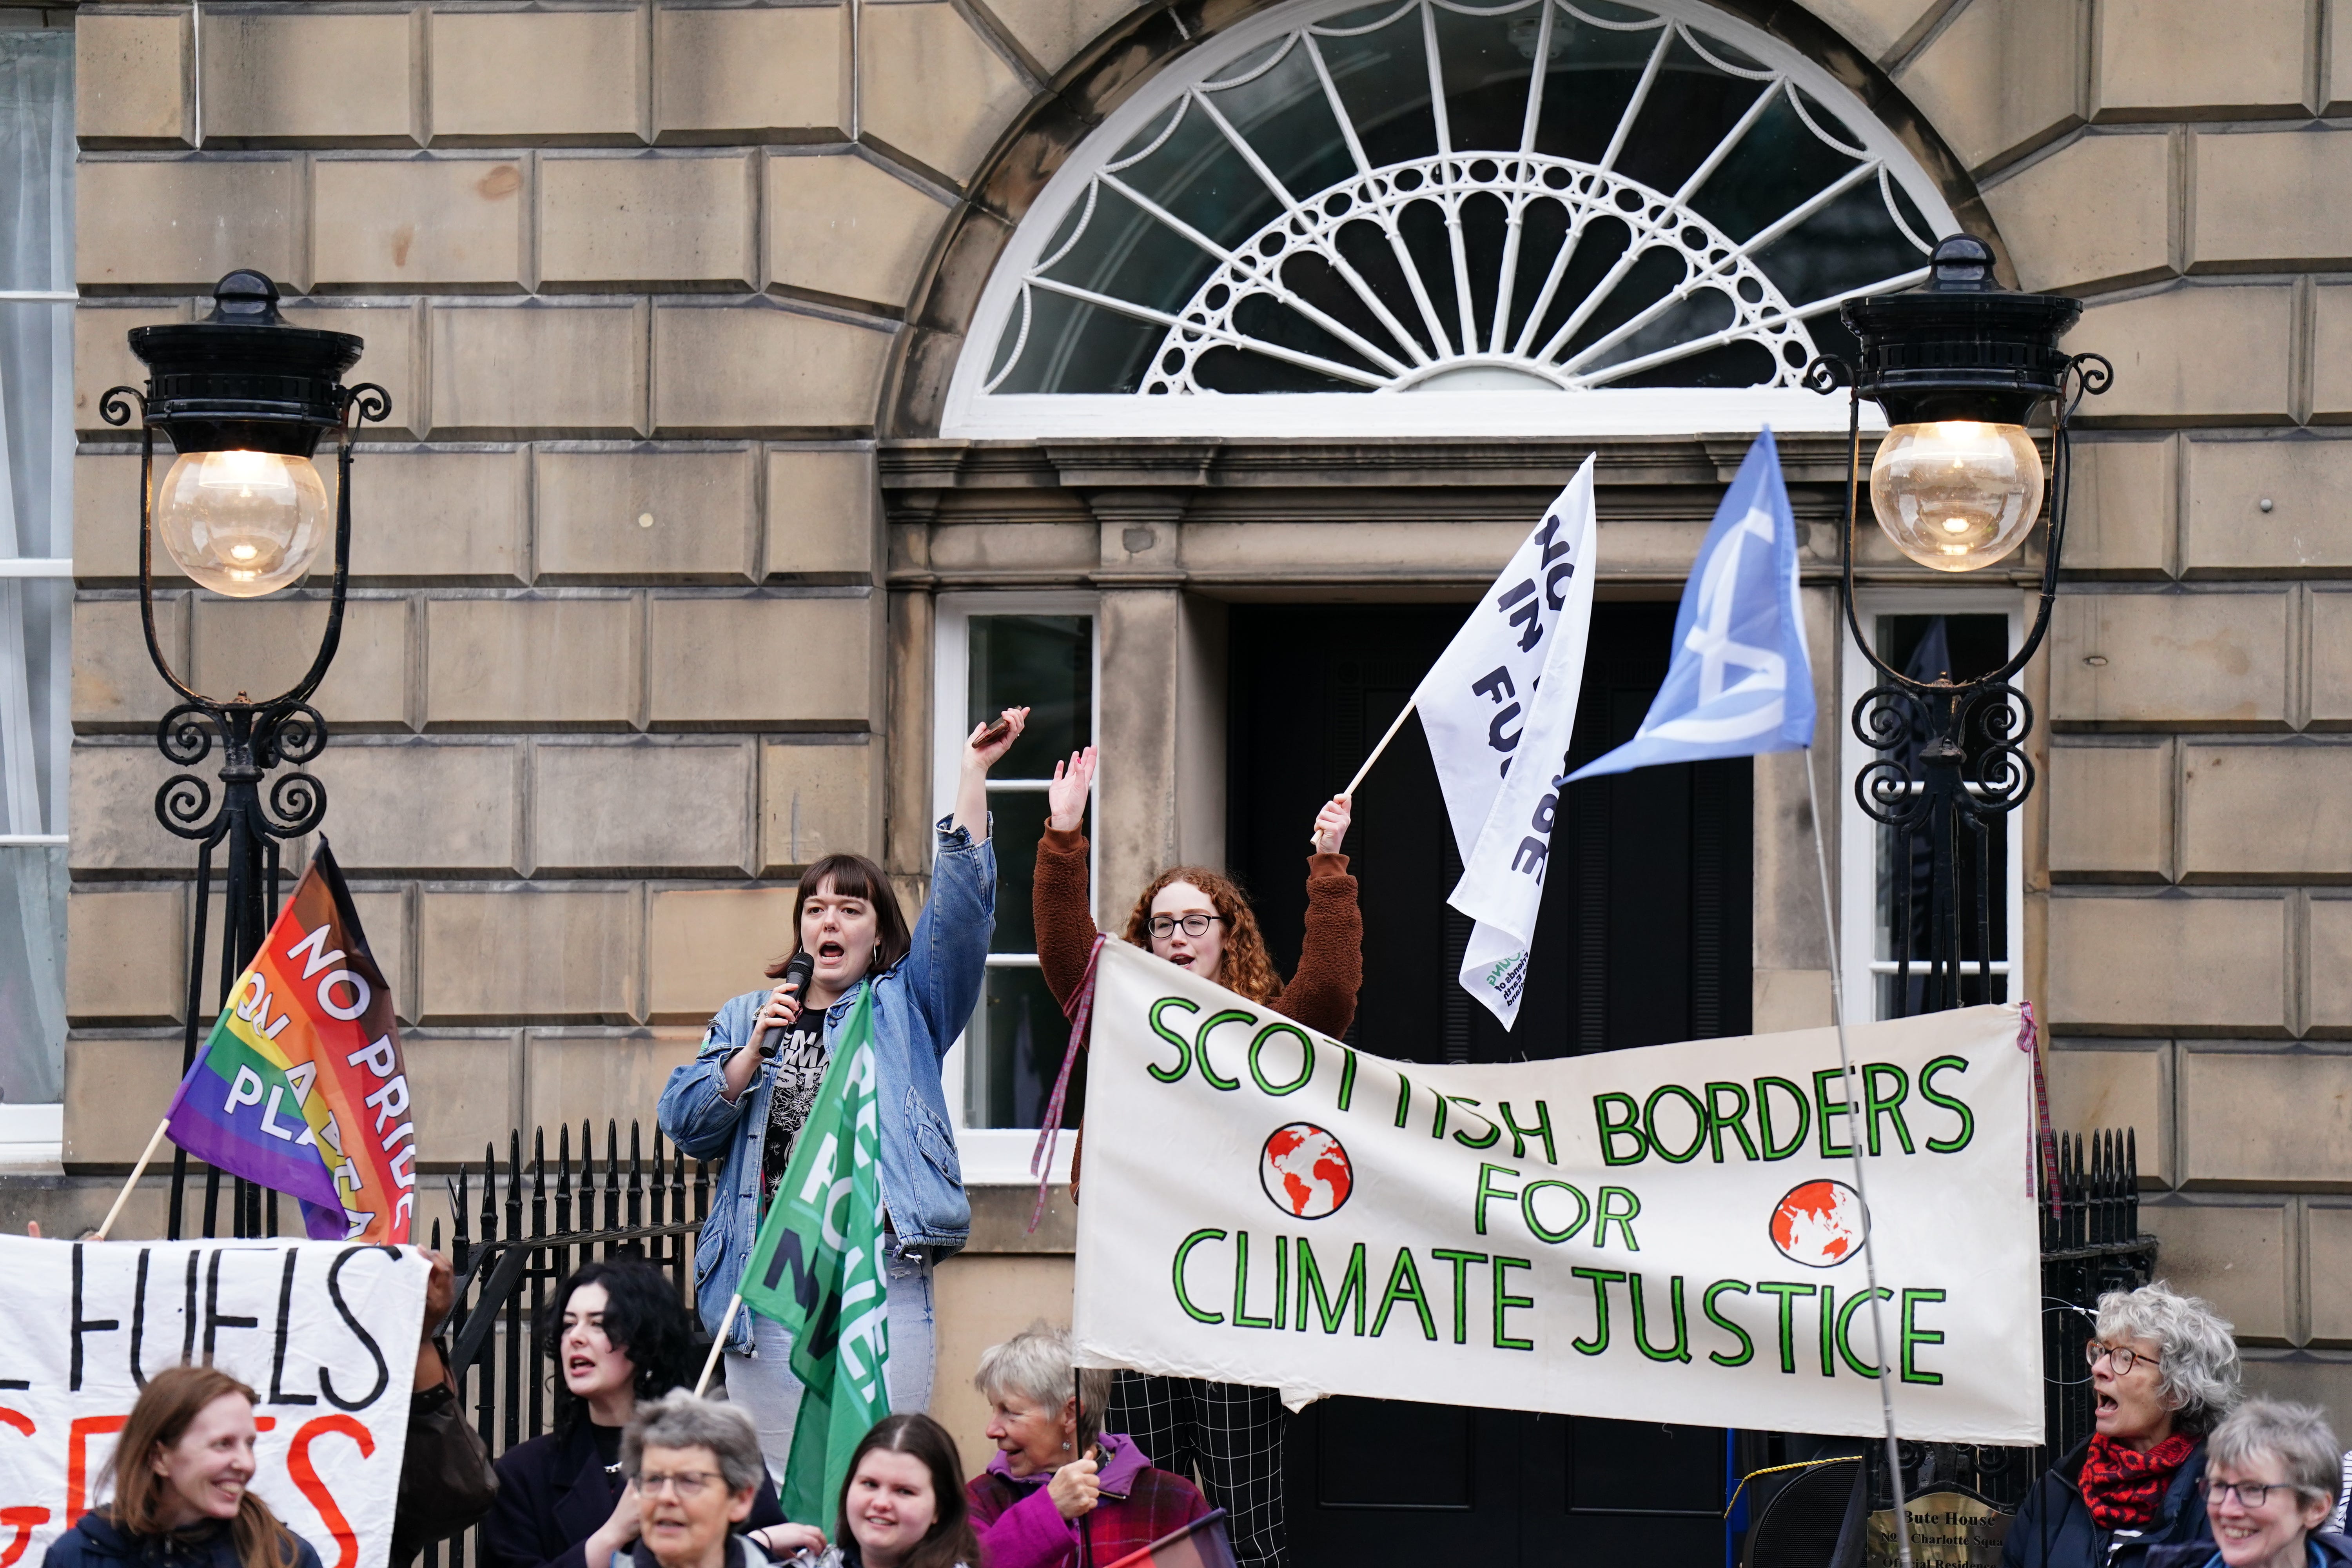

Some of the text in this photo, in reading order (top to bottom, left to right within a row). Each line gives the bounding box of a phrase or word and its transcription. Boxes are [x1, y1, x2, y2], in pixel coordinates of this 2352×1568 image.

[1497, 578, 1544, 653] IN
[287, 924, 372, 1021] NO
[1593, 1055, 1975, 1167] BORDERS
[1474, 1161, 1642, 1252] FOR
[1172, 1227, 1947, 1386] CLIMATE JUSTICE
[1904, 1510, 1996, 1527] Bute House
[1910, 1533, 1970, 1546] Charlotte
